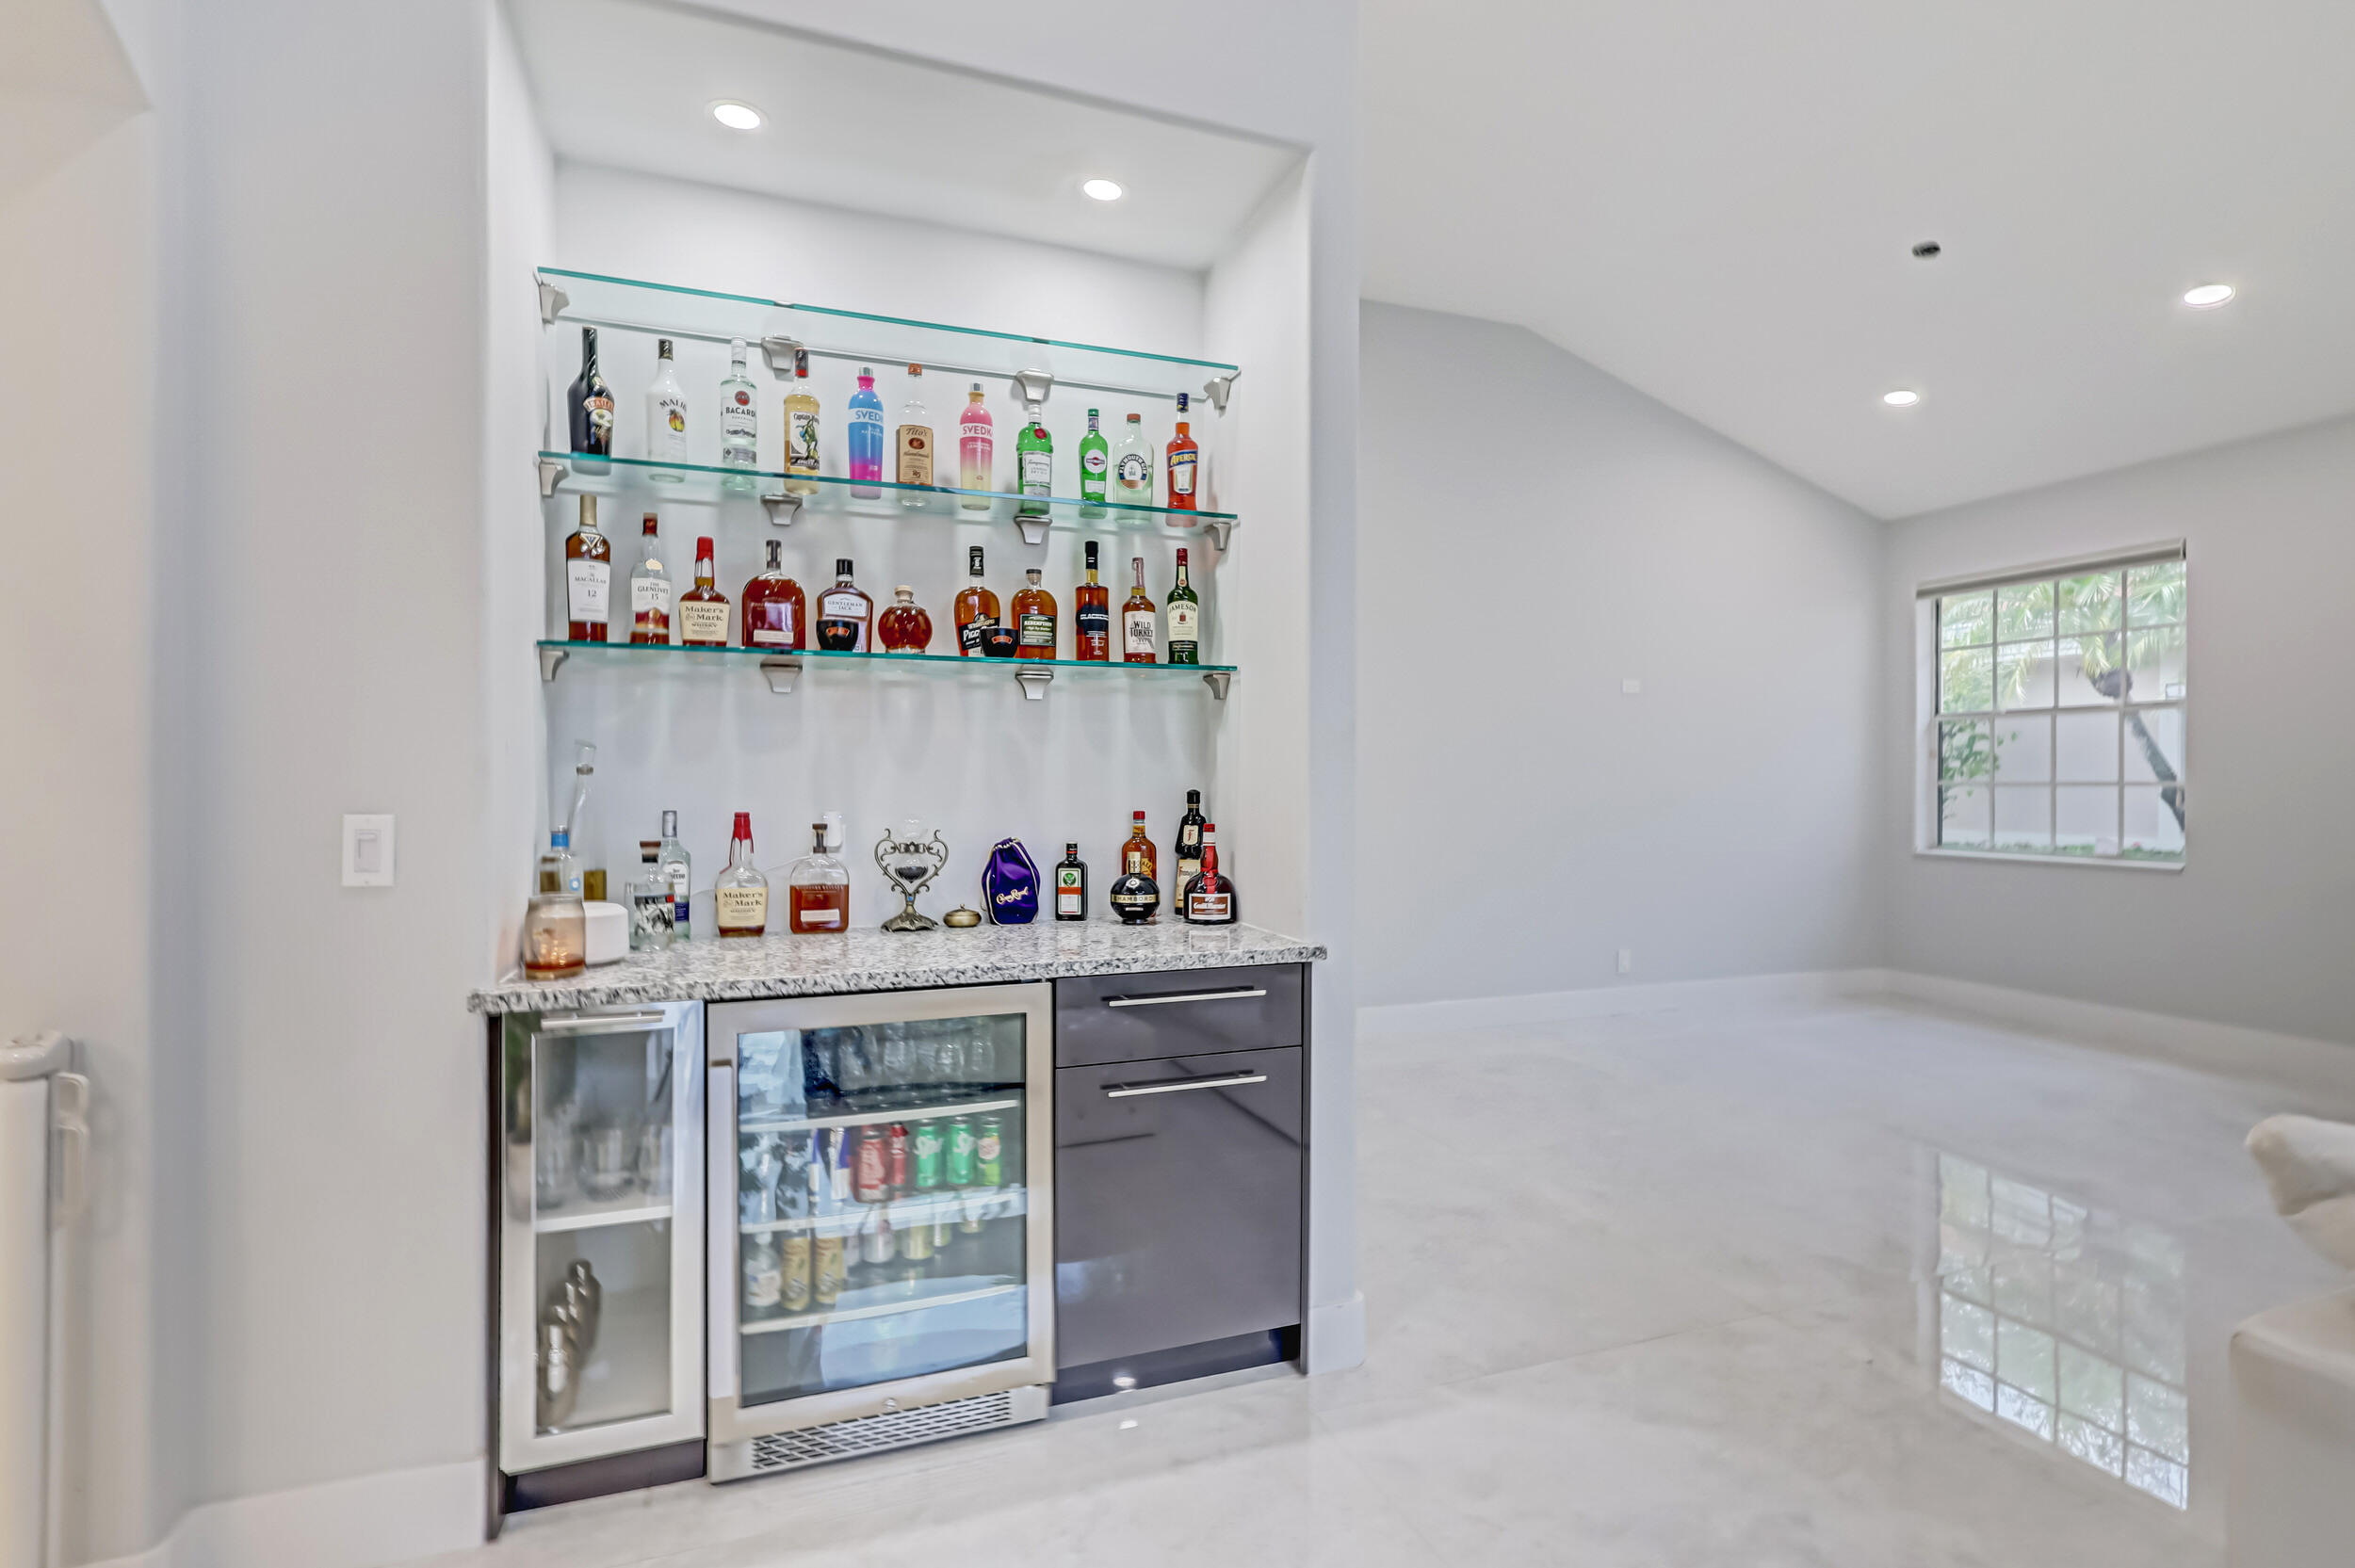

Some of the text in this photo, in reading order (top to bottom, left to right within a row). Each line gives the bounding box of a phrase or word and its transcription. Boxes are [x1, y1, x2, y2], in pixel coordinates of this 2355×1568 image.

[1170, 453, 1196, 465] APEROL
[1168, 604, 1197, 615] JAMESON
[1133, 621, 1151, 630] WILD
